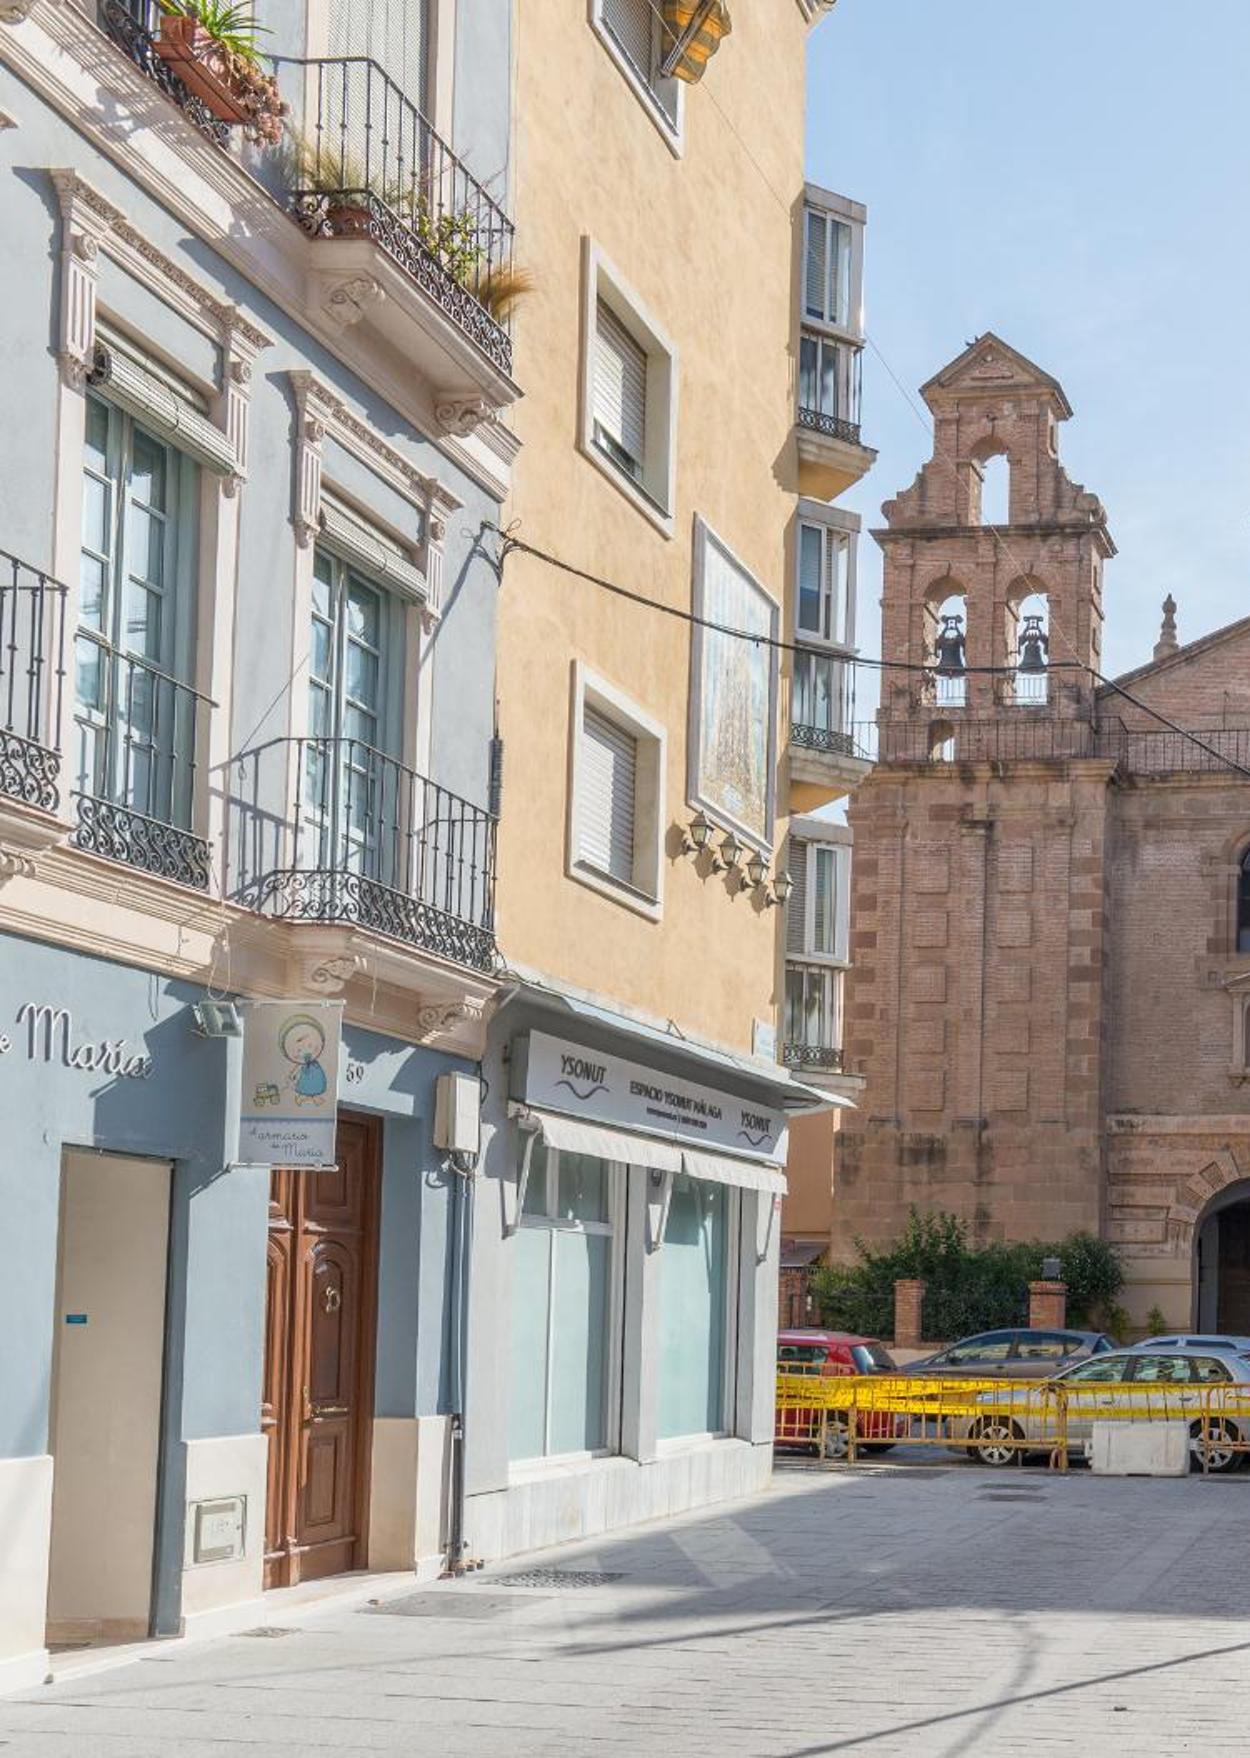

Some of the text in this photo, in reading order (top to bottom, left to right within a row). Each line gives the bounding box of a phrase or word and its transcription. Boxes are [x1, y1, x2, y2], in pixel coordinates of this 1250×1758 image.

[16, 1002, 154, 1079] María
[346, 1063, 364, 1084] 59
[560, 1053, 607, 1084] YSONUT
[630, 1081, 663, 1101] ESPACIO
[664, 1091, 694, 1111] YSONUT
[741, 1109, 771, 1133] YSONUT
